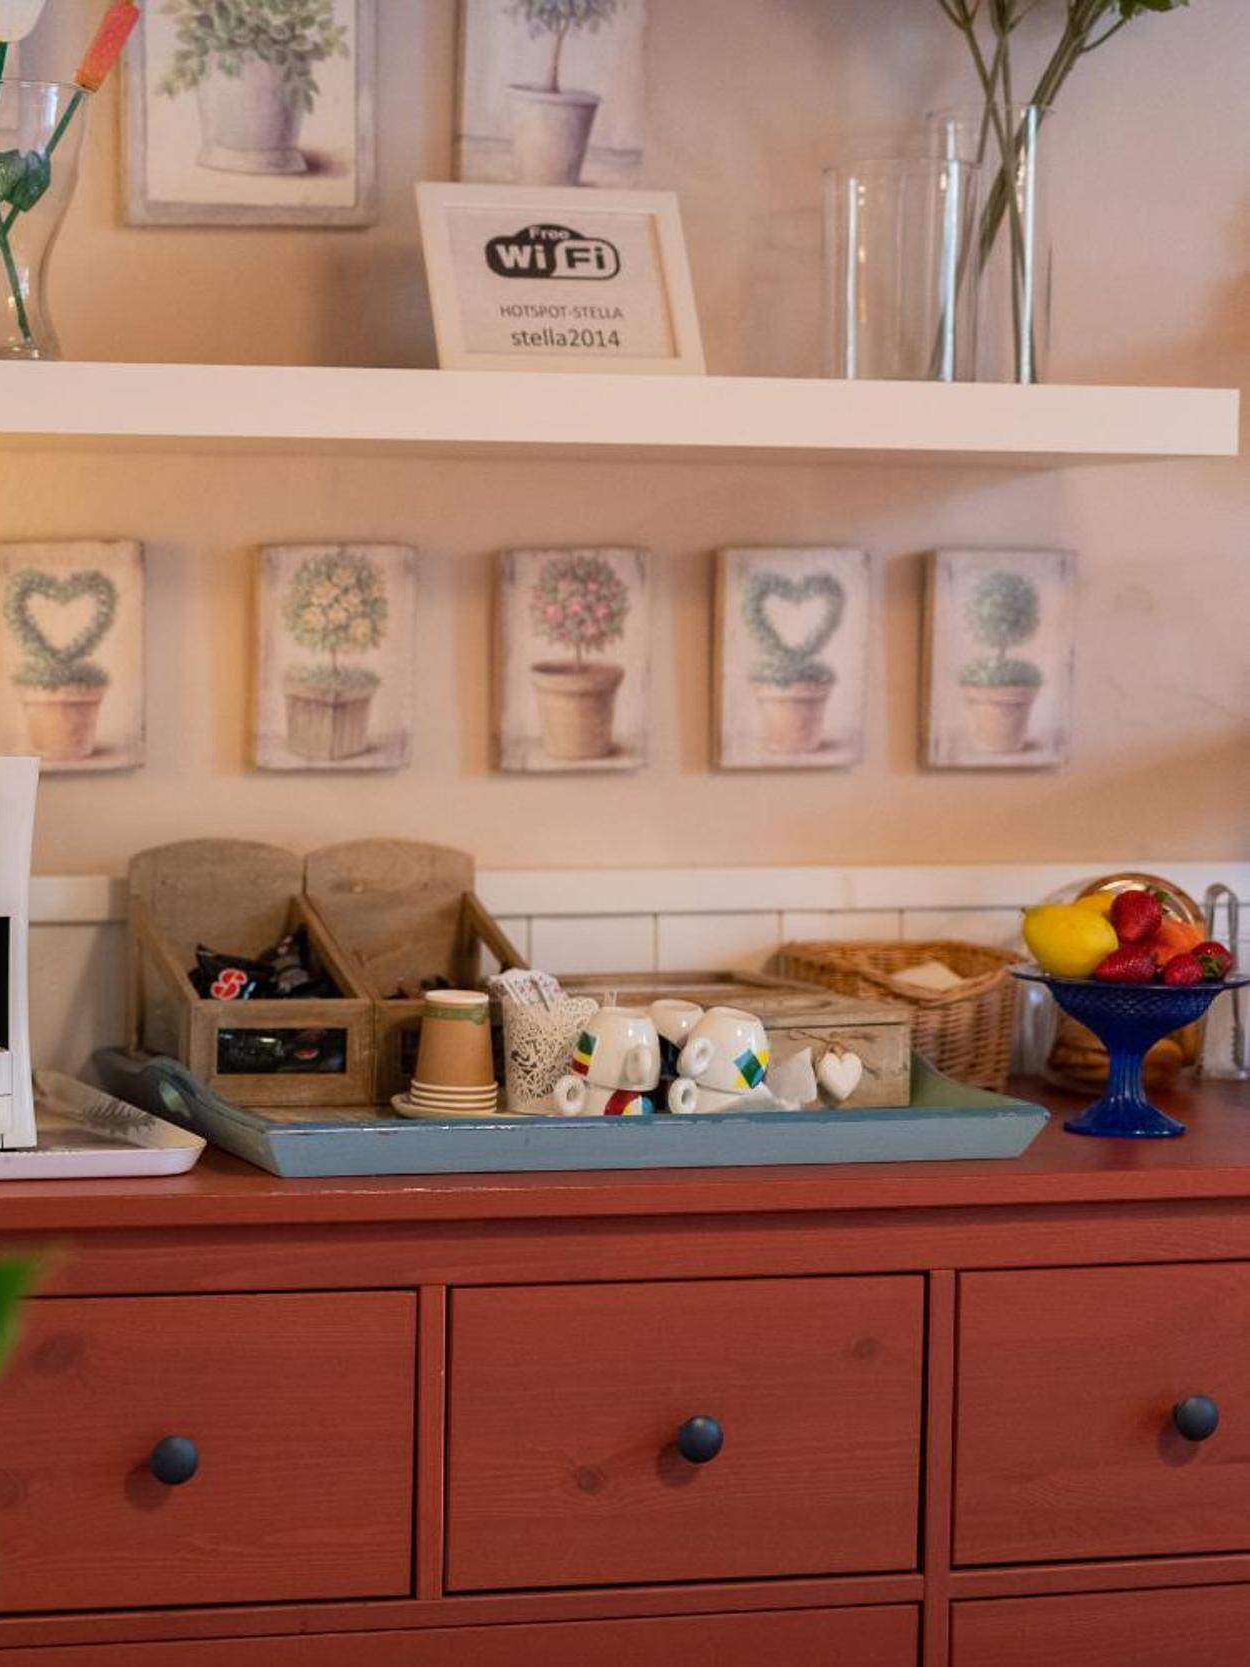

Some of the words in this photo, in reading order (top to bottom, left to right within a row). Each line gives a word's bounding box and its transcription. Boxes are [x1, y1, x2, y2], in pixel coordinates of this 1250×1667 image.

[530, 225, 570, 240] Free
[499, 304, 623, 320] HOTSPOT-STELLA
[510, 328, 620, 348] stella2014
